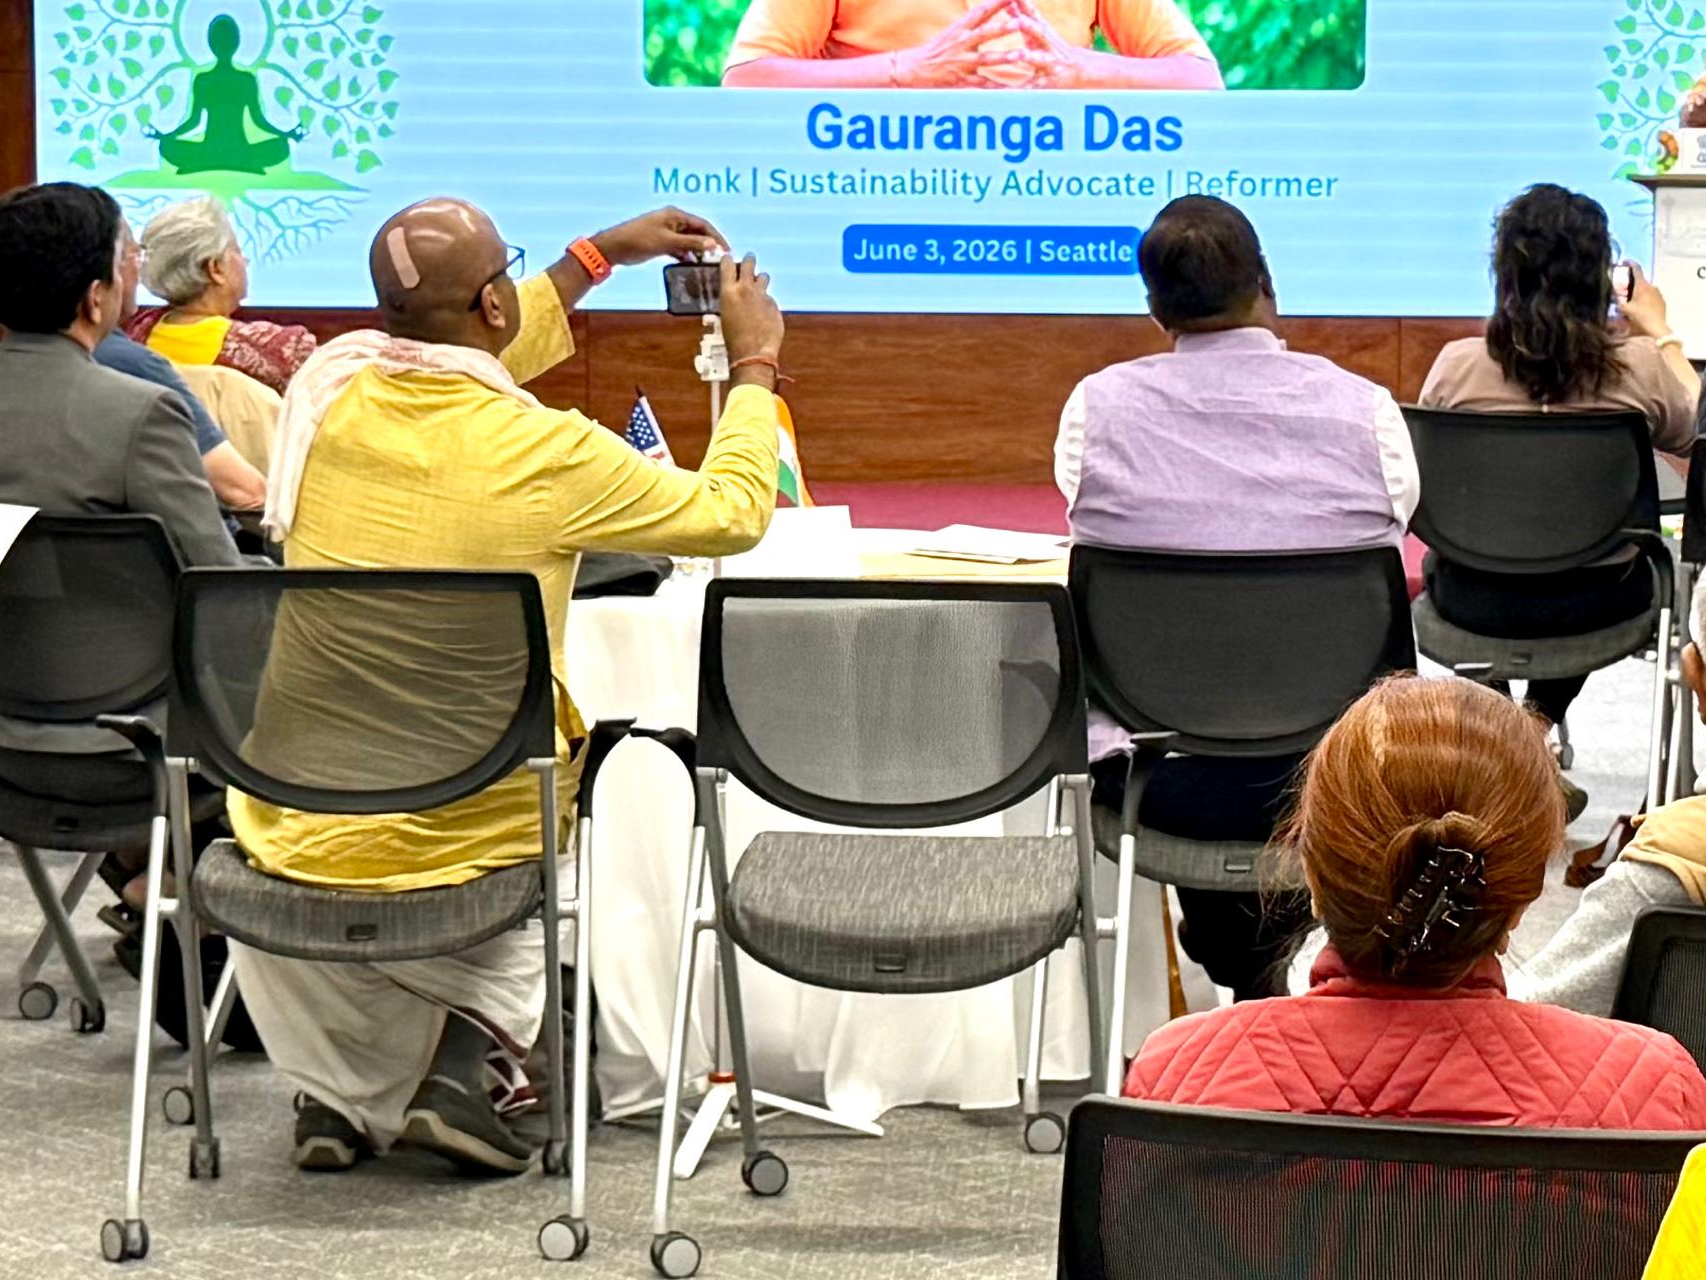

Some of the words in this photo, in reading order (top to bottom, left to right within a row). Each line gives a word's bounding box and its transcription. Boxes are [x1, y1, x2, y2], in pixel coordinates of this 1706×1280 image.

[806, 103, 1063, 163] Gauranga
[1084, 104, 1183, 152] Das
[653, 166, 741, 194] Monk
[769, 168, 992, 203] Sustainability
[1001, 169, 1156, 197] Advocate
[1186, 170, 1339, 198] Reformer
[853, 239, 918, 261] June
[924, 240, 946, 265] 3,
[955, 240, 1018, 262] 2026
[1039, 239, 1132, 263] Seattle
